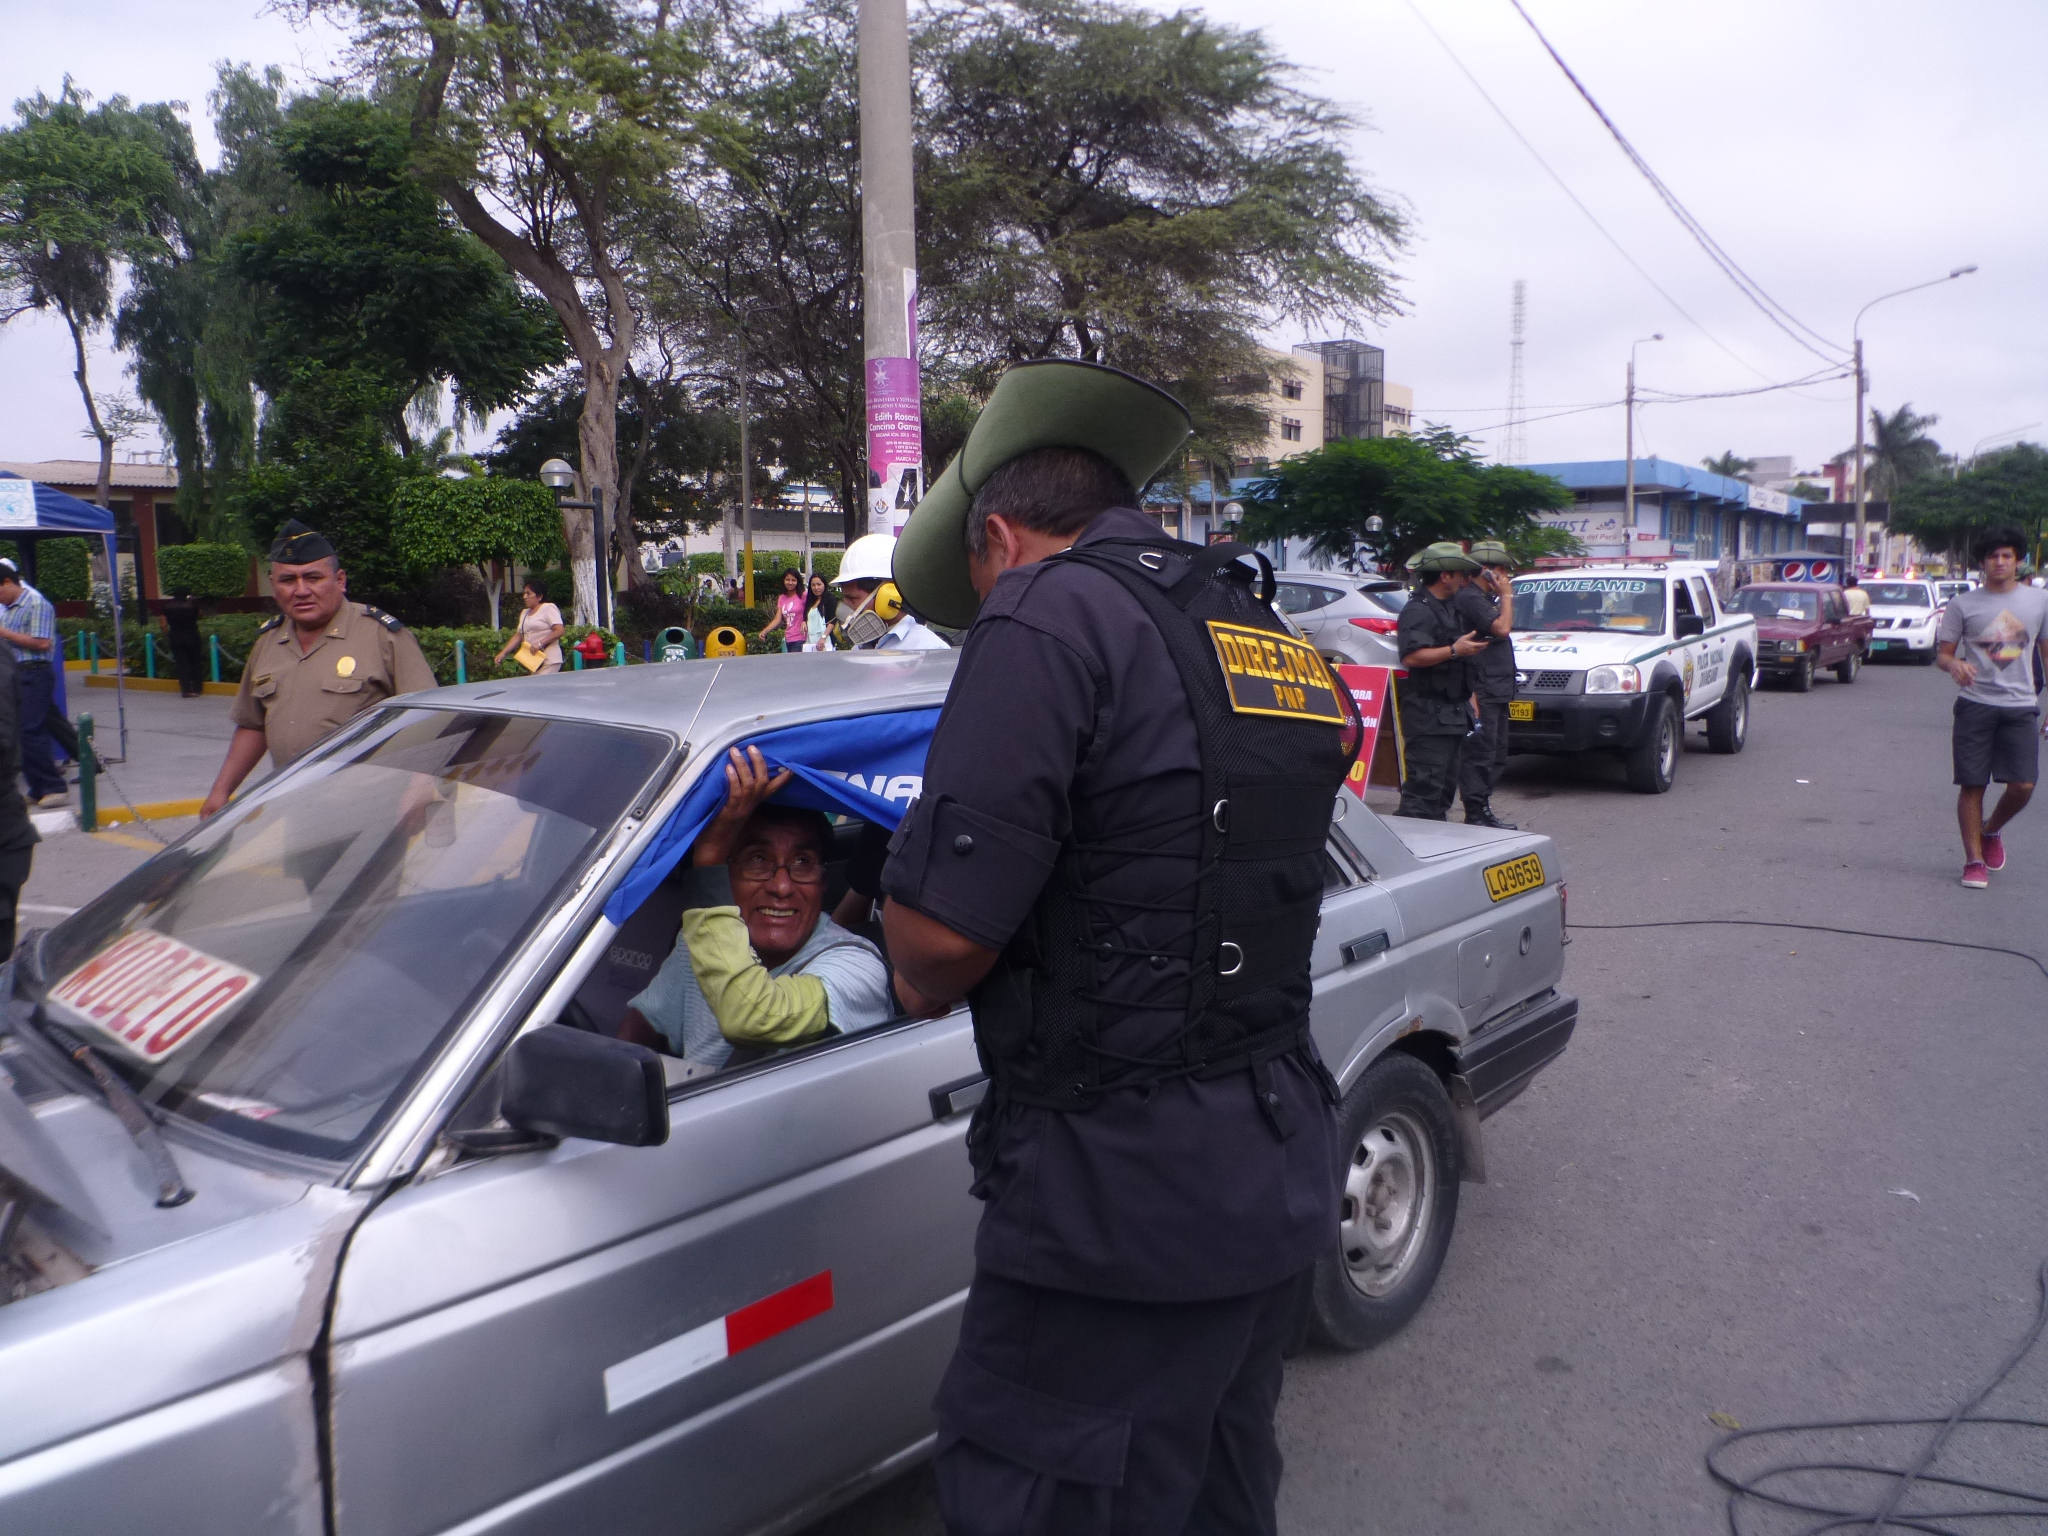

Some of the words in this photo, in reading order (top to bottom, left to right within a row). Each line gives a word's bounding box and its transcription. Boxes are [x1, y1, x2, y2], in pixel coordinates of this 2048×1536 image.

[874, 412, 893, 422] Edith
[894, 412, 919, 423] Rosario
[869, 422, 896, 432] Cancino
[1517, 580, 1646, 595] DIVMEAMB
[1513, 645, 1578, 654] LICIA
[1216, 632, 1332, 690] DIREJMA
[1272, 684, 1306, 711] PNP
[1511, 708, 1530, 717] 0193
